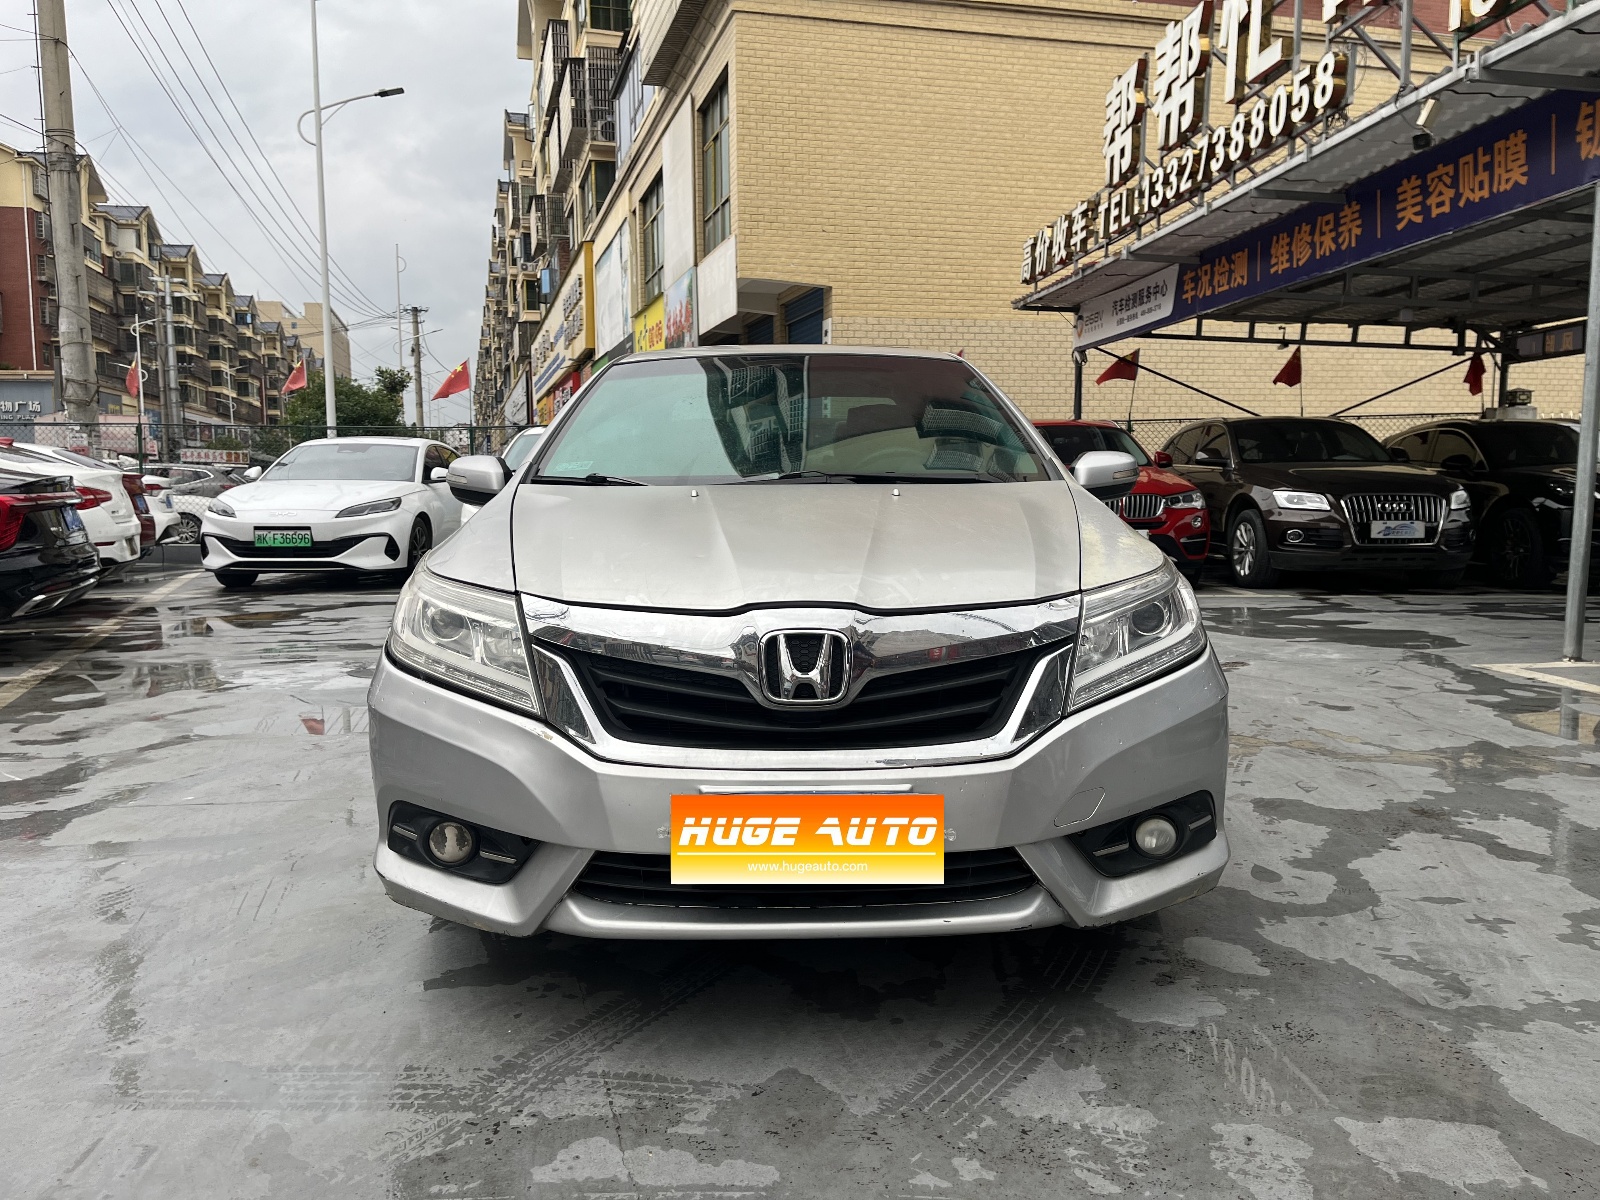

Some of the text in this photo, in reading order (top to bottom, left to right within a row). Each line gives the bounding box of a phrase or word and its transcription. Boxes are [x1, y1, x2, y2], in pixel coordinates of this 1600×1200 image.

[1020, 201, 1088, 284] 高价收车
[1182, 247, 1248, 304] 车况检测
[1270, 201, 1363, 275] 维修保养
[1396, 129, 1528, 231] 美容贴膜
[0, 400, 41, 412] 物广场
